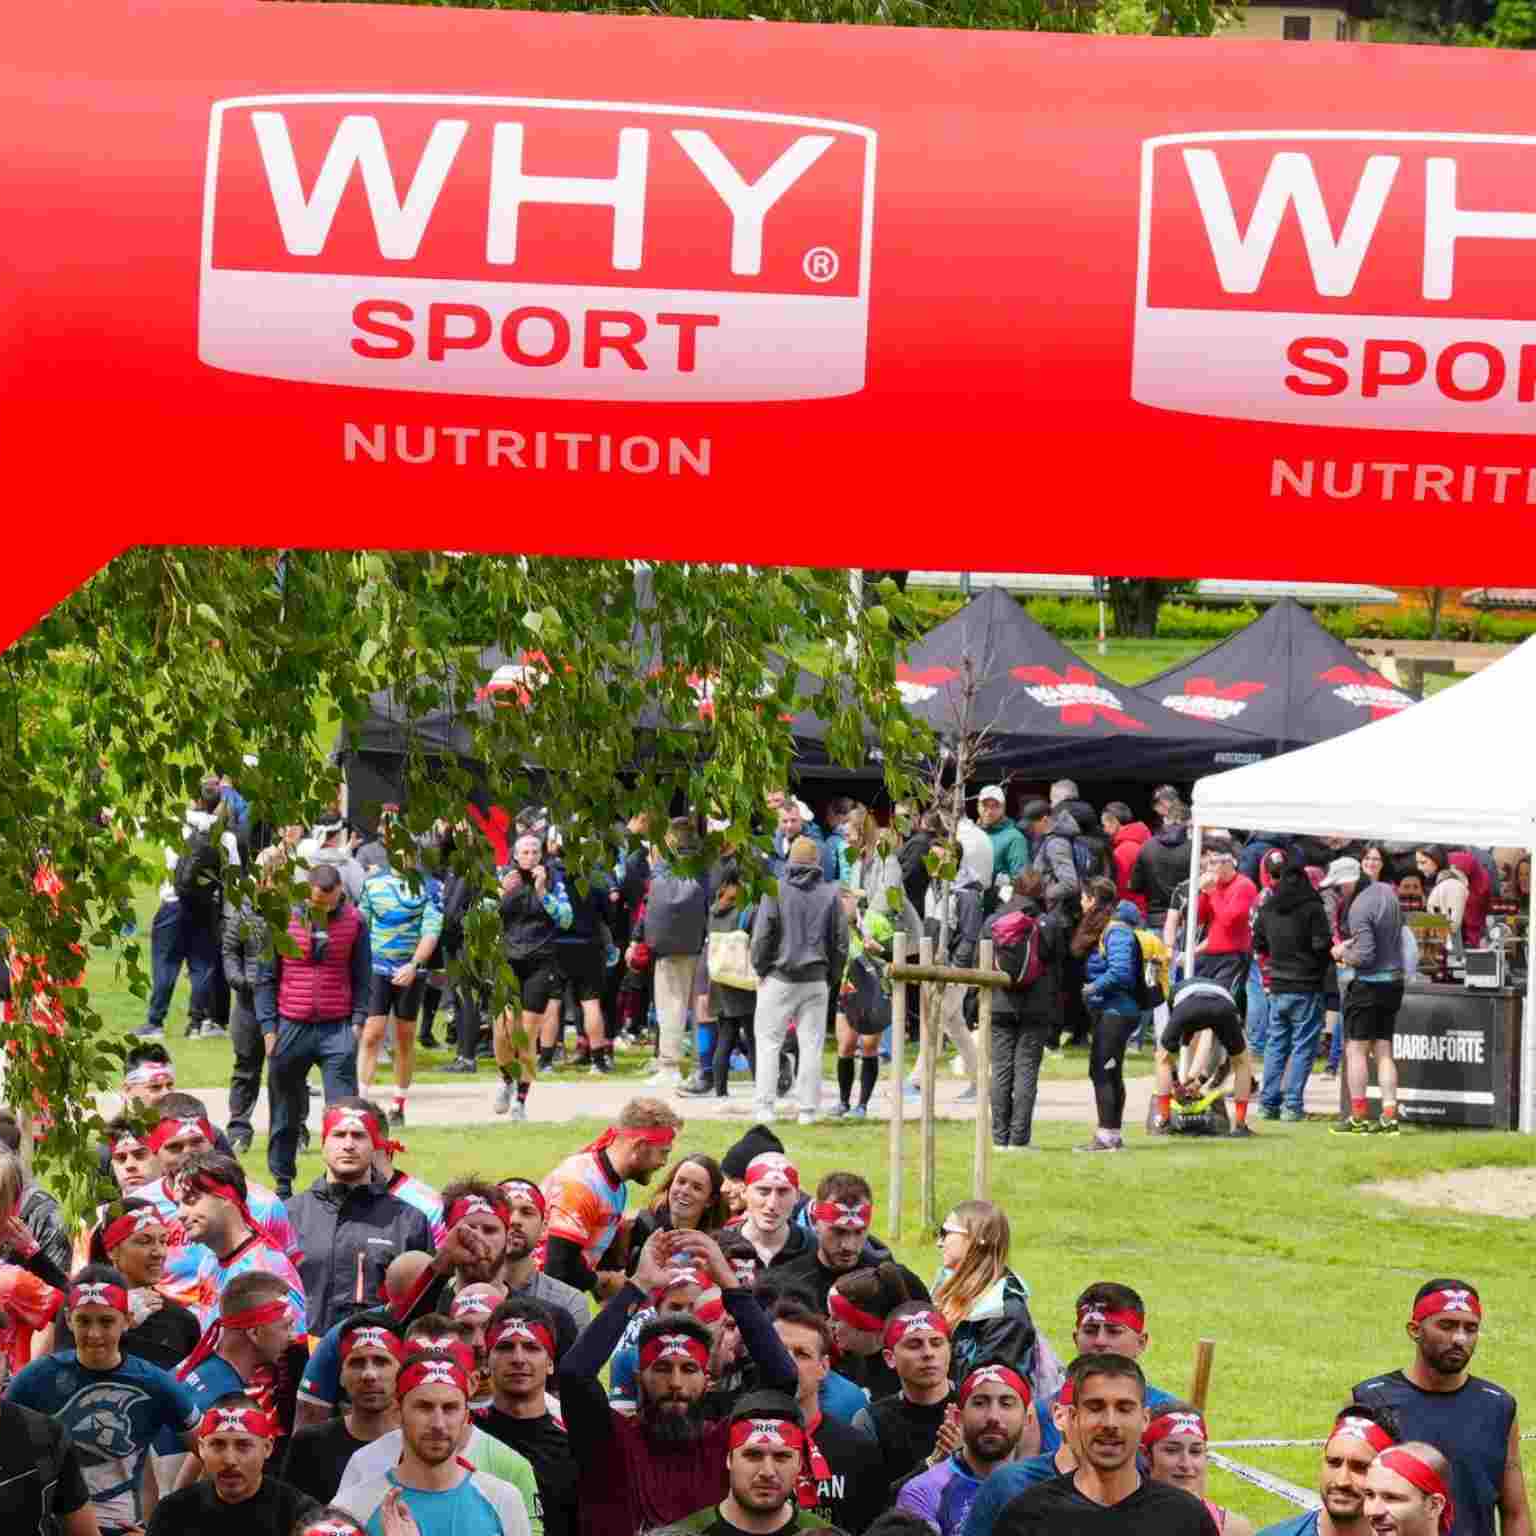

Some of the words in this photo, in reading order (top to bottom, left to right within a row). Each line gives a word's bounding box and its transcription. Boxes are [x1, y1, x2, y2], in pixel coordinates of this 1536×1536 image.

[350, 299, 719, 373] SPORT
[344, 423, 712, 476] NUTRITION
[1393, 1034, 1485, 1064] BARBAFORTE
